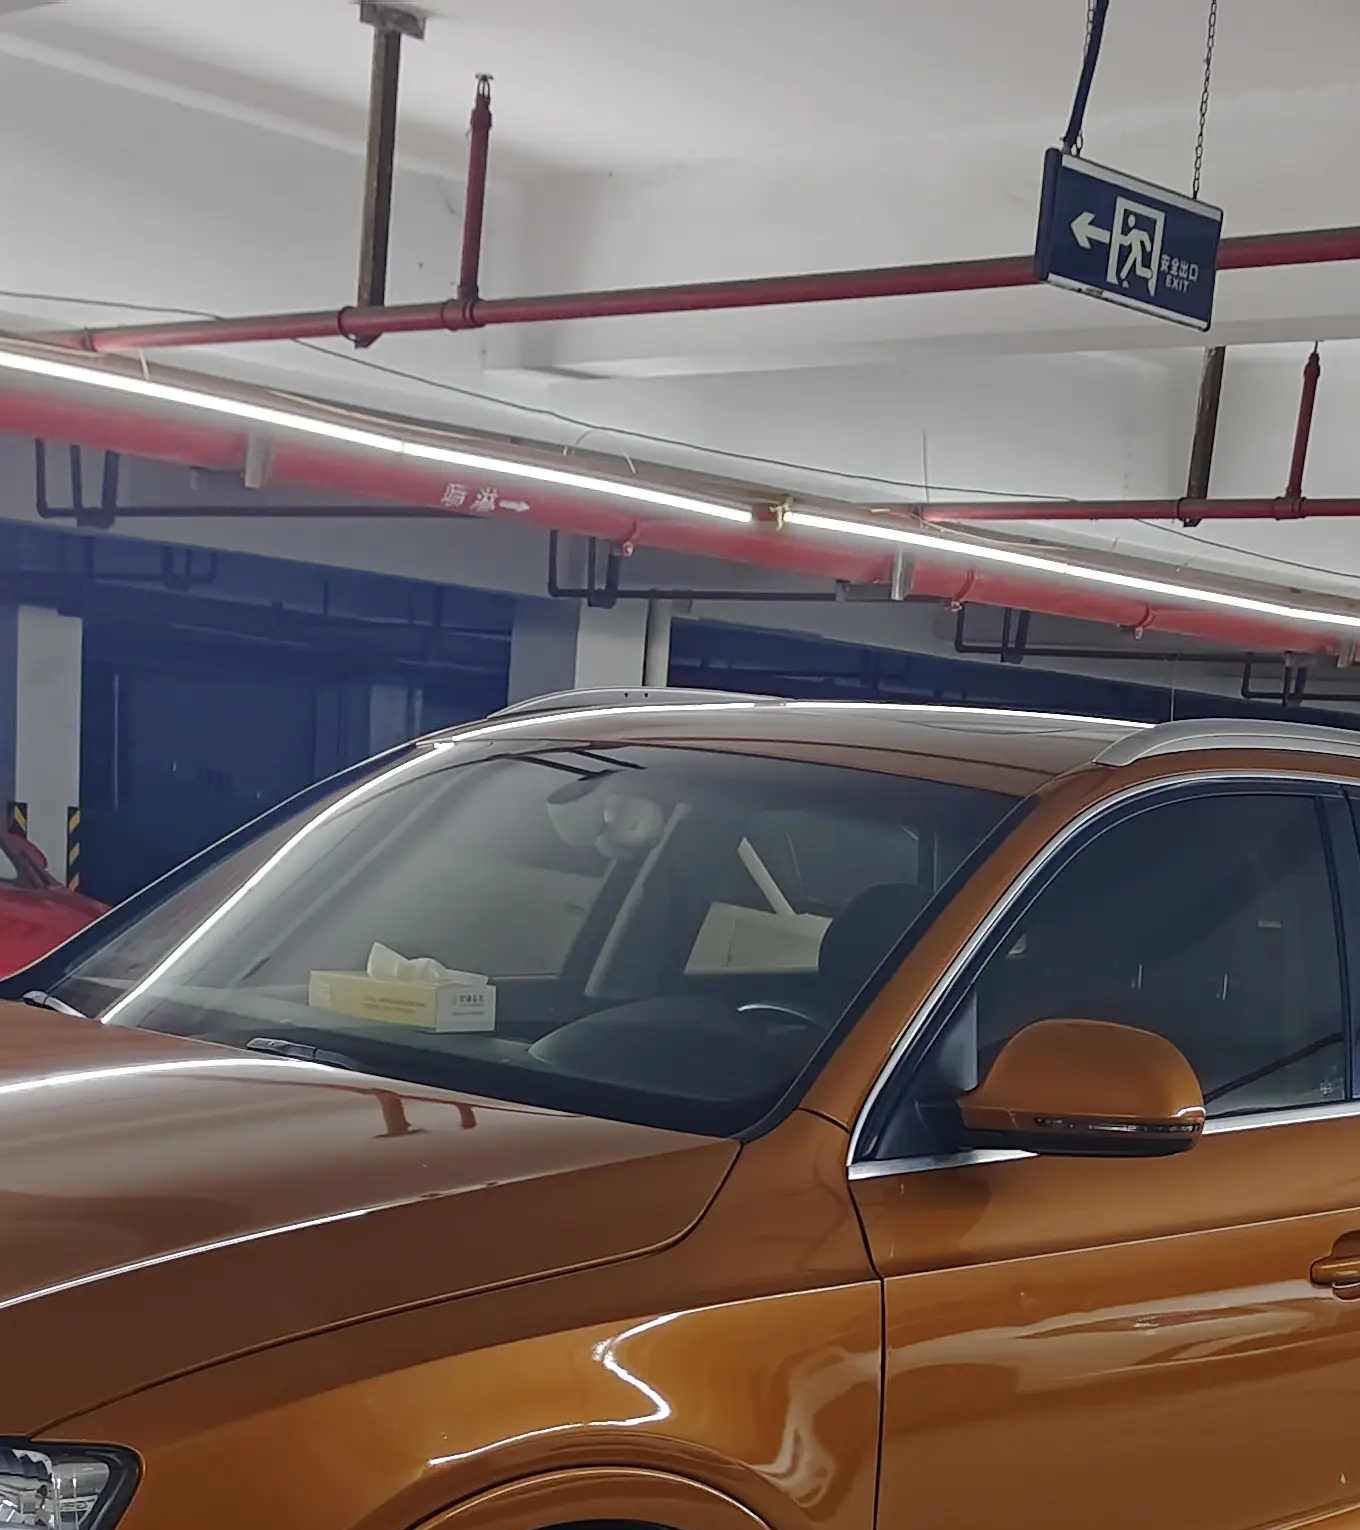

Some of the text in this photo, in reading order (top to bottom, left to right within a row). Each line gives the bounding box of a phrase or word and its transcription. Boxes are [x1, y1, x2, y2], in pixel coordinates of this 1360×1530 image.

[1160, 254, 1199, 282] 安全出口
[1165, 274, 1189, 293] EXIT
